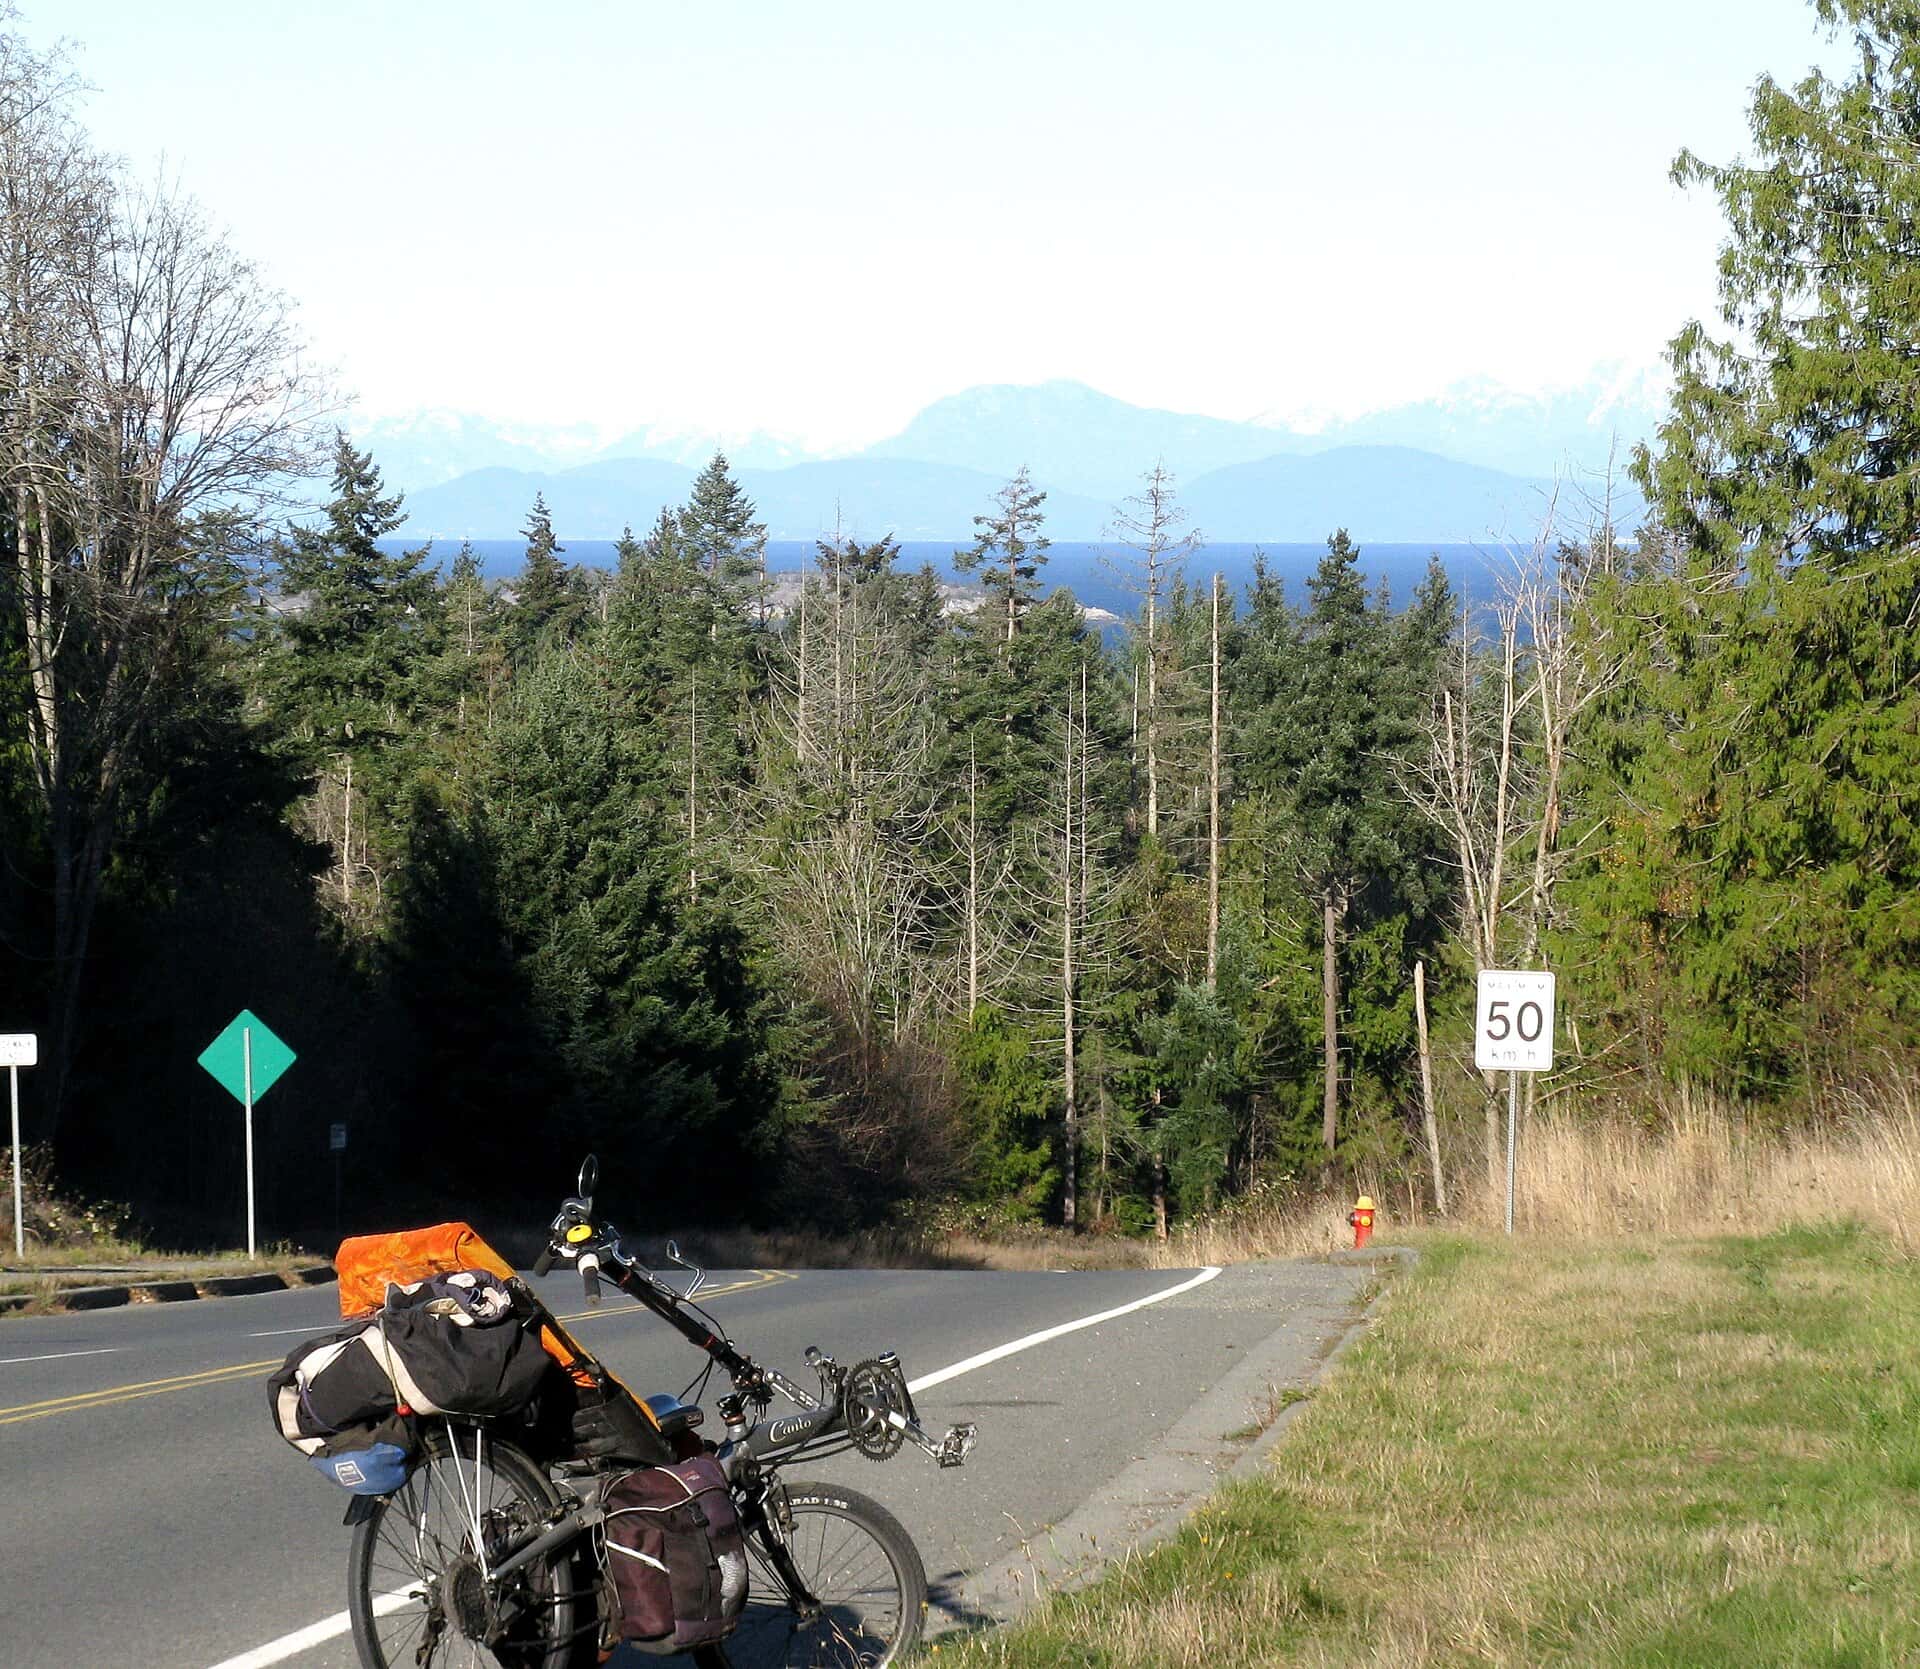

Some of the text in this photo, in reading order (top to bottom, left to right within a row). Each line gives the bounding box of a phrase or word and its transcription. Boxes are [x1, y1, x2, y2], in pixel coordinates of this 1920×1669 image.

[1486, 1001, 1543, 1042] 50
[1491, 1047, 1536, 1061] kmh
[769, 1416, 812, 1443] Canto
